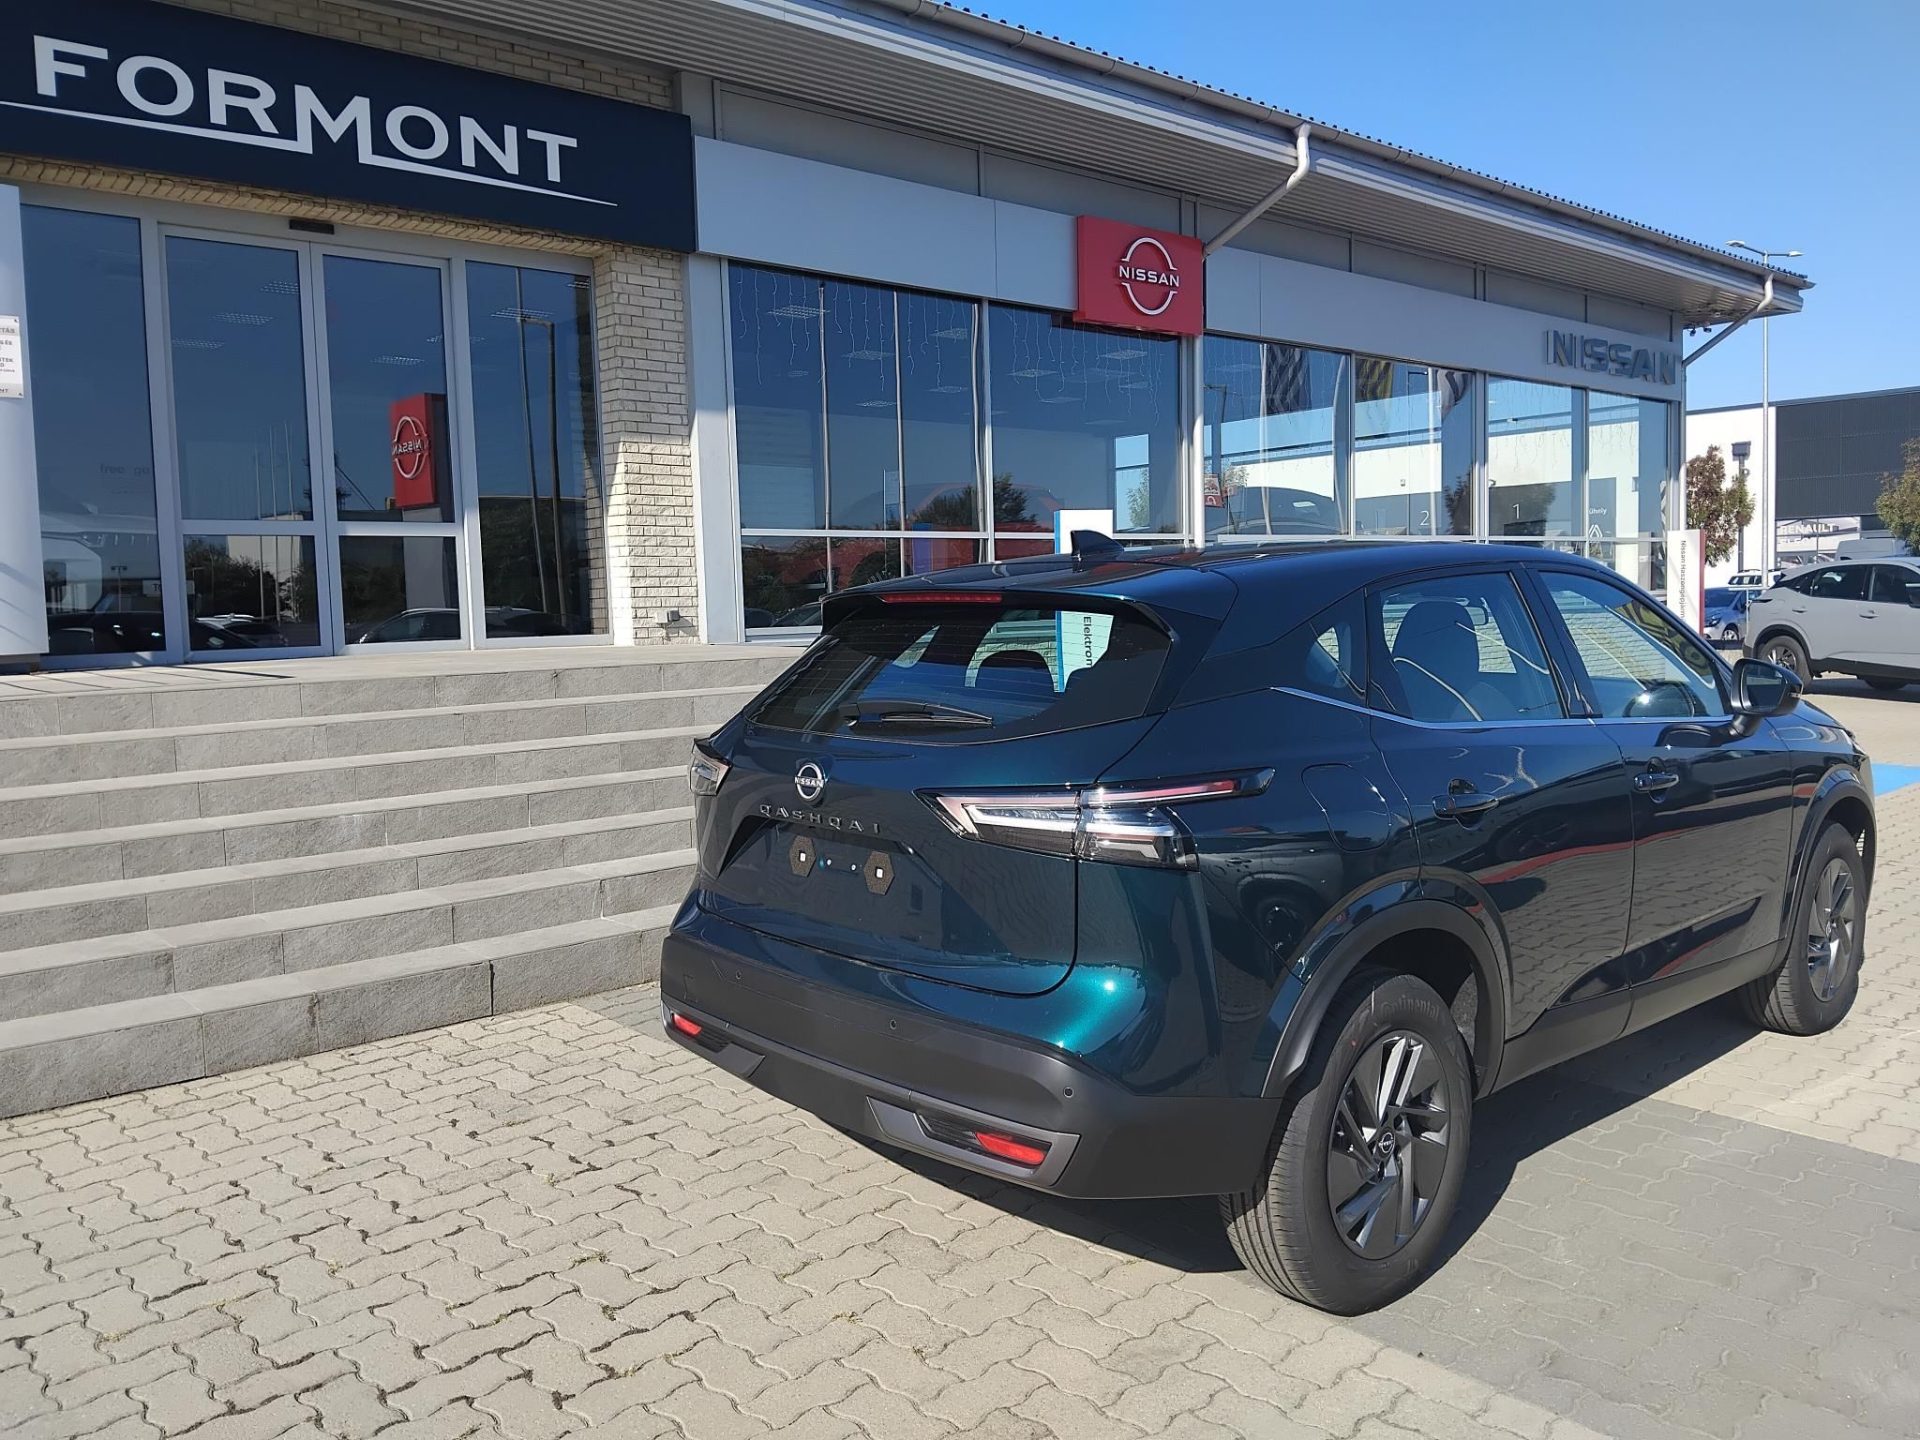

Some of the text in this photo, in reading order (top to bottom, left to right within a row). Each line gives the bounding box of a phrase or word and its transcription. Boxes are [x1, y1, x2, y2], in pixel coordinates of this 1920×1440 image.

[34, 35, 578, 182] FORMONT
[1119, 264, 1180, 288] NISSAN
[1545, 329, 1676, 386] NISSAN
[1420, 510, 1430, 526] 2
[1512, 503, 1520, 520] 1
[1779, 523, 1836, 535] RENAULT
[794, 776, 825, 789] NISSAN
[759, 803, 880, 835] QASHQAI
[1381, 994, 1441, 1020] Continental
